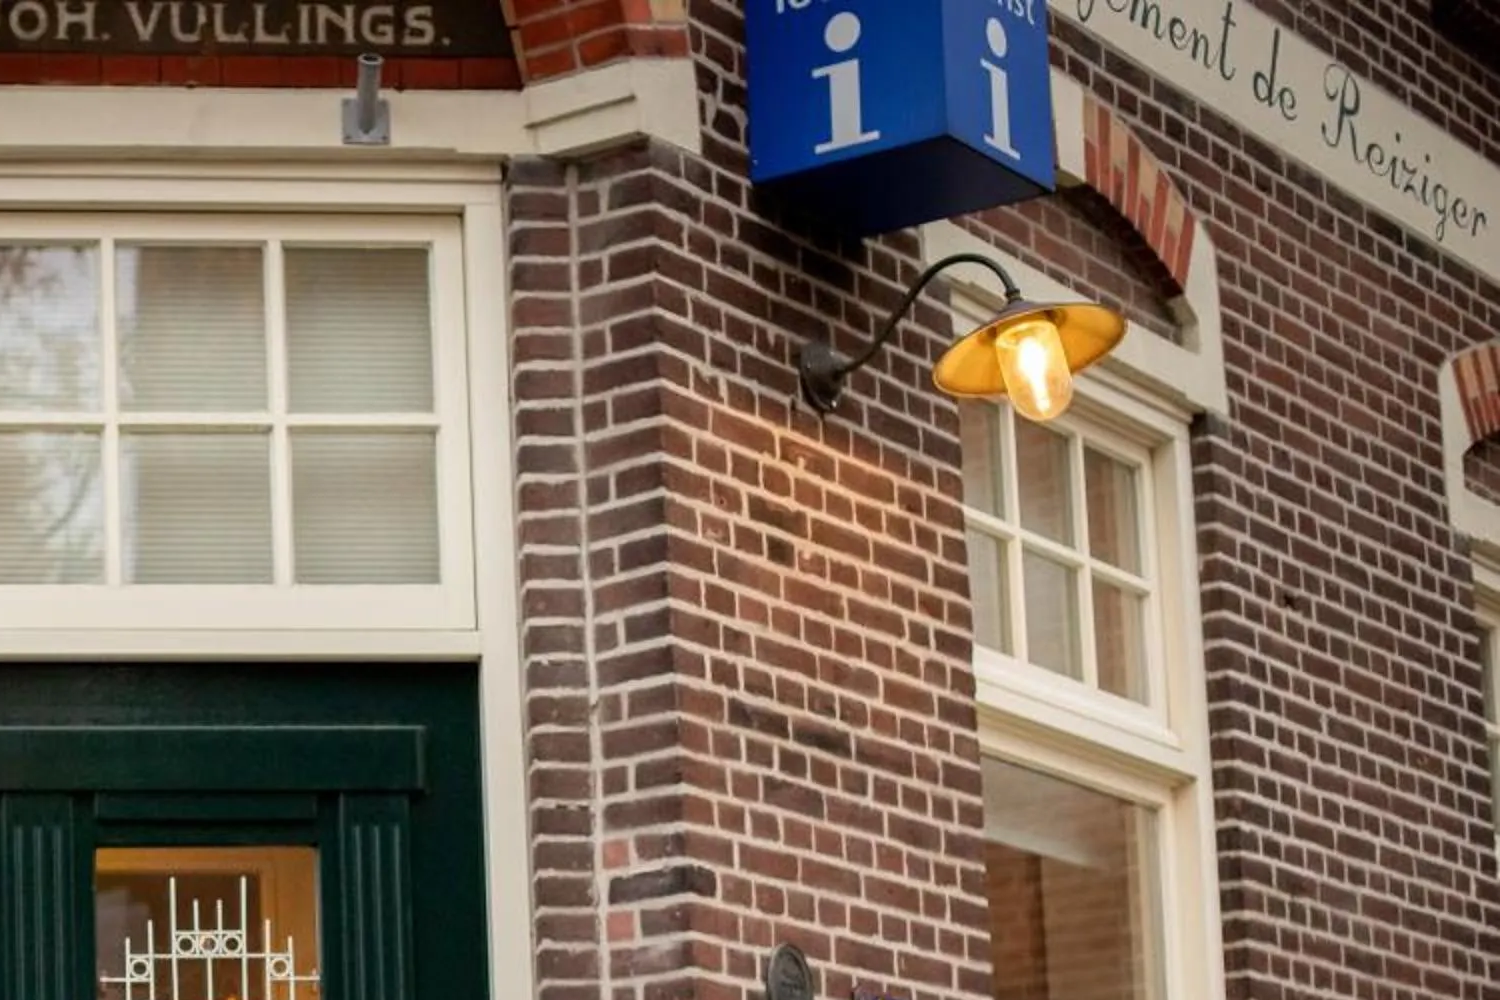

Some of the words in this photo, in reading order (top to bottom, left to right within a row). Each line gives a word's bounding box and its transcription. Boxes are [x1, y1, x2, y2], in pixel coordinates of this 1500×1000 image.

[125, 0, 451, 46] VULLINGS.
[1252, 27, 1298, 121] de
[1321, 63, 1487, 240] Reiziger
